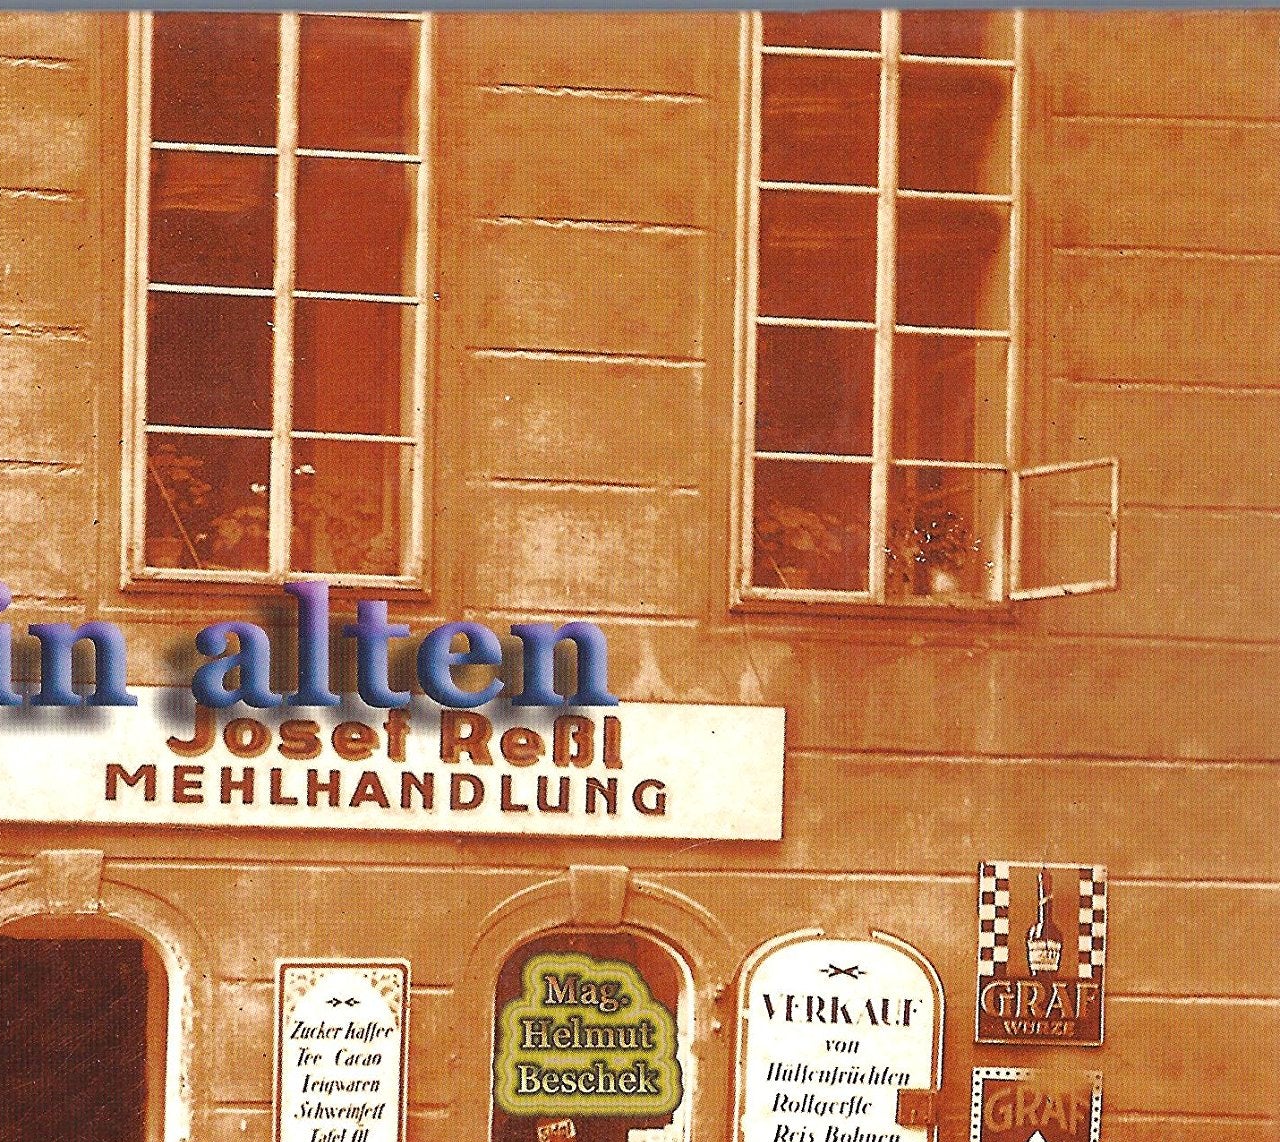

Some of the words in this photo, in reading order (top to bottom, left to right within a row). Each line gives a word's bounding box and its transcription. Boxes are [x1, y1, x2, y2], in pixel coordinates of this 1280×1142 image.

[166, 703, 413, 765] Josef
[104, 762, 668, 817] MEHLHANDLUNG
[762, 993, 923, 1027] VERKAUF
[980, 980, 1100, 1020] GRAF
[290, 1020, 343, 1040] Zucker
[825, 1038, 860, 1054] von
[297, 1047, 322, 1067] Tee
[334, 1048, 382, 1067] Cacao
[302, 1073, 380, 1095] Teigwaren
[984, 1086, 1090, 1135] GRAF
